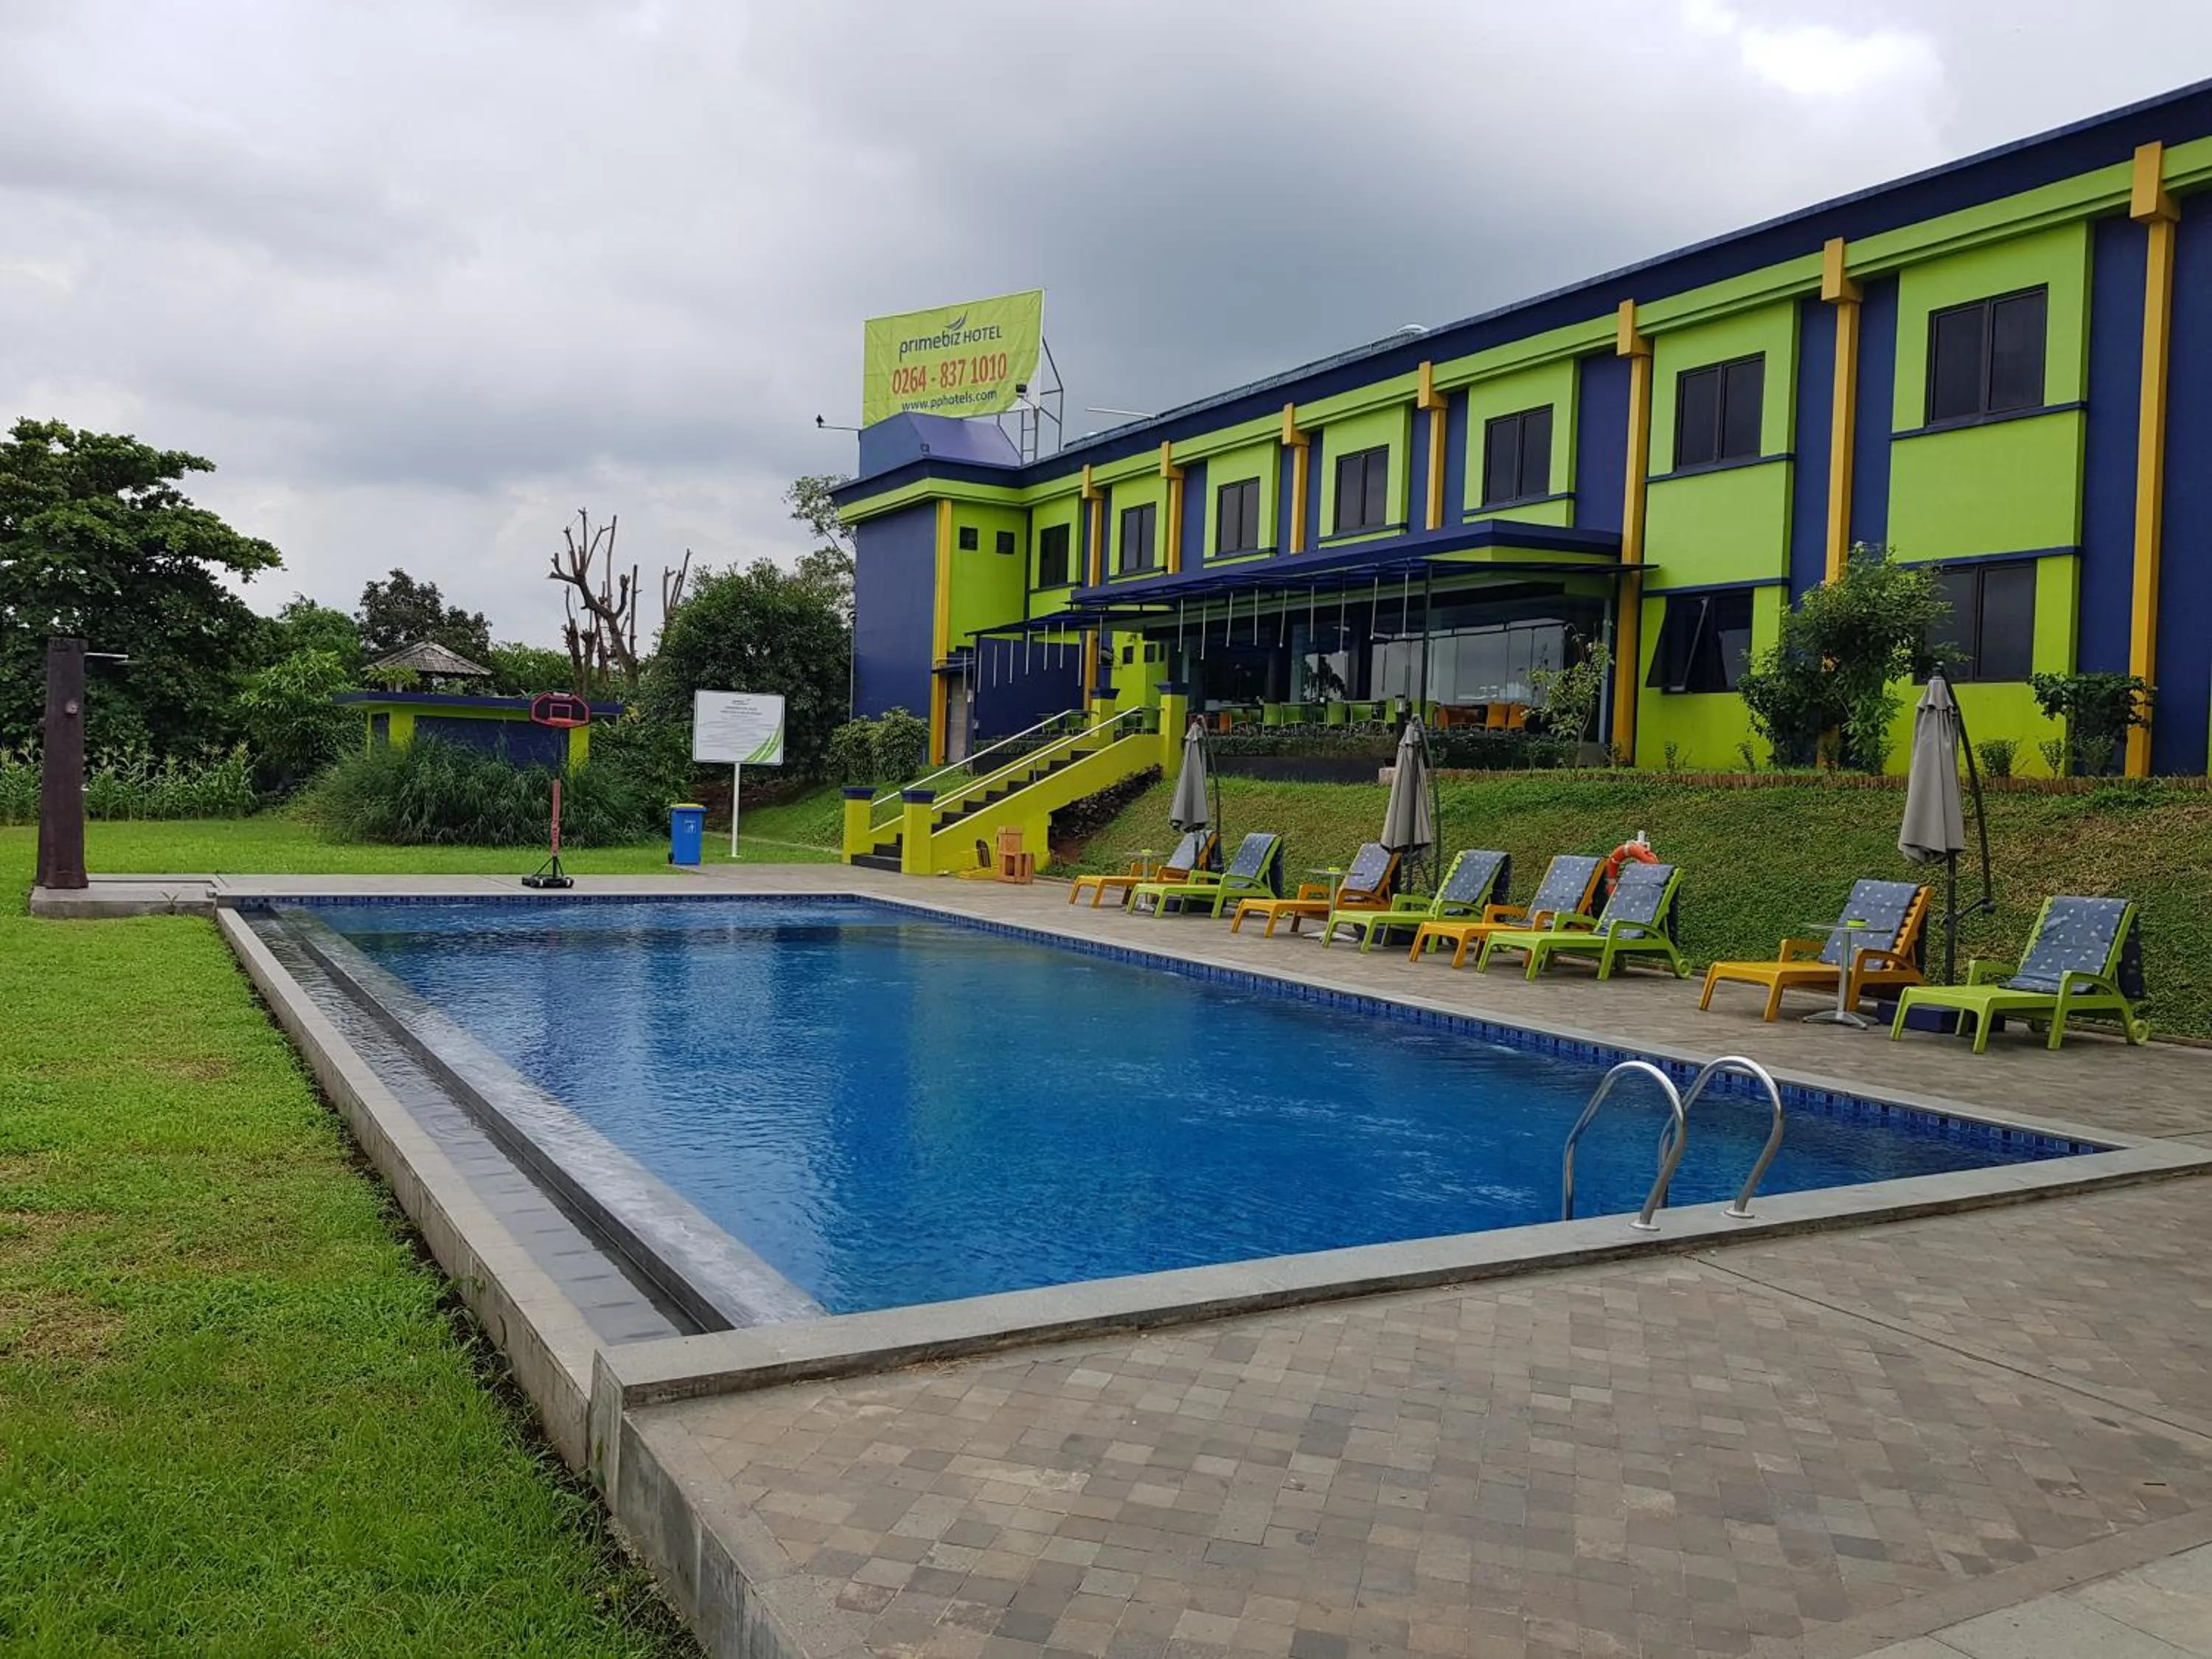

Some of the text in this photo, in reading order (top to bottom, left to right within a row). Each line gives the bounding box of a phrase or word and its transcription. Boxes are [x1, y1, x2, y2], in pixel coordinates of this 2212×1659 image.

[899, 325, 1002, 363] primebiz HOTEL
[891, 365, 927, 394] 0264
[939, 359, 967, 389] 837
[970, 352, 1007, 384] 1010
[902, 390, 997, 411] www.pphotels.com
